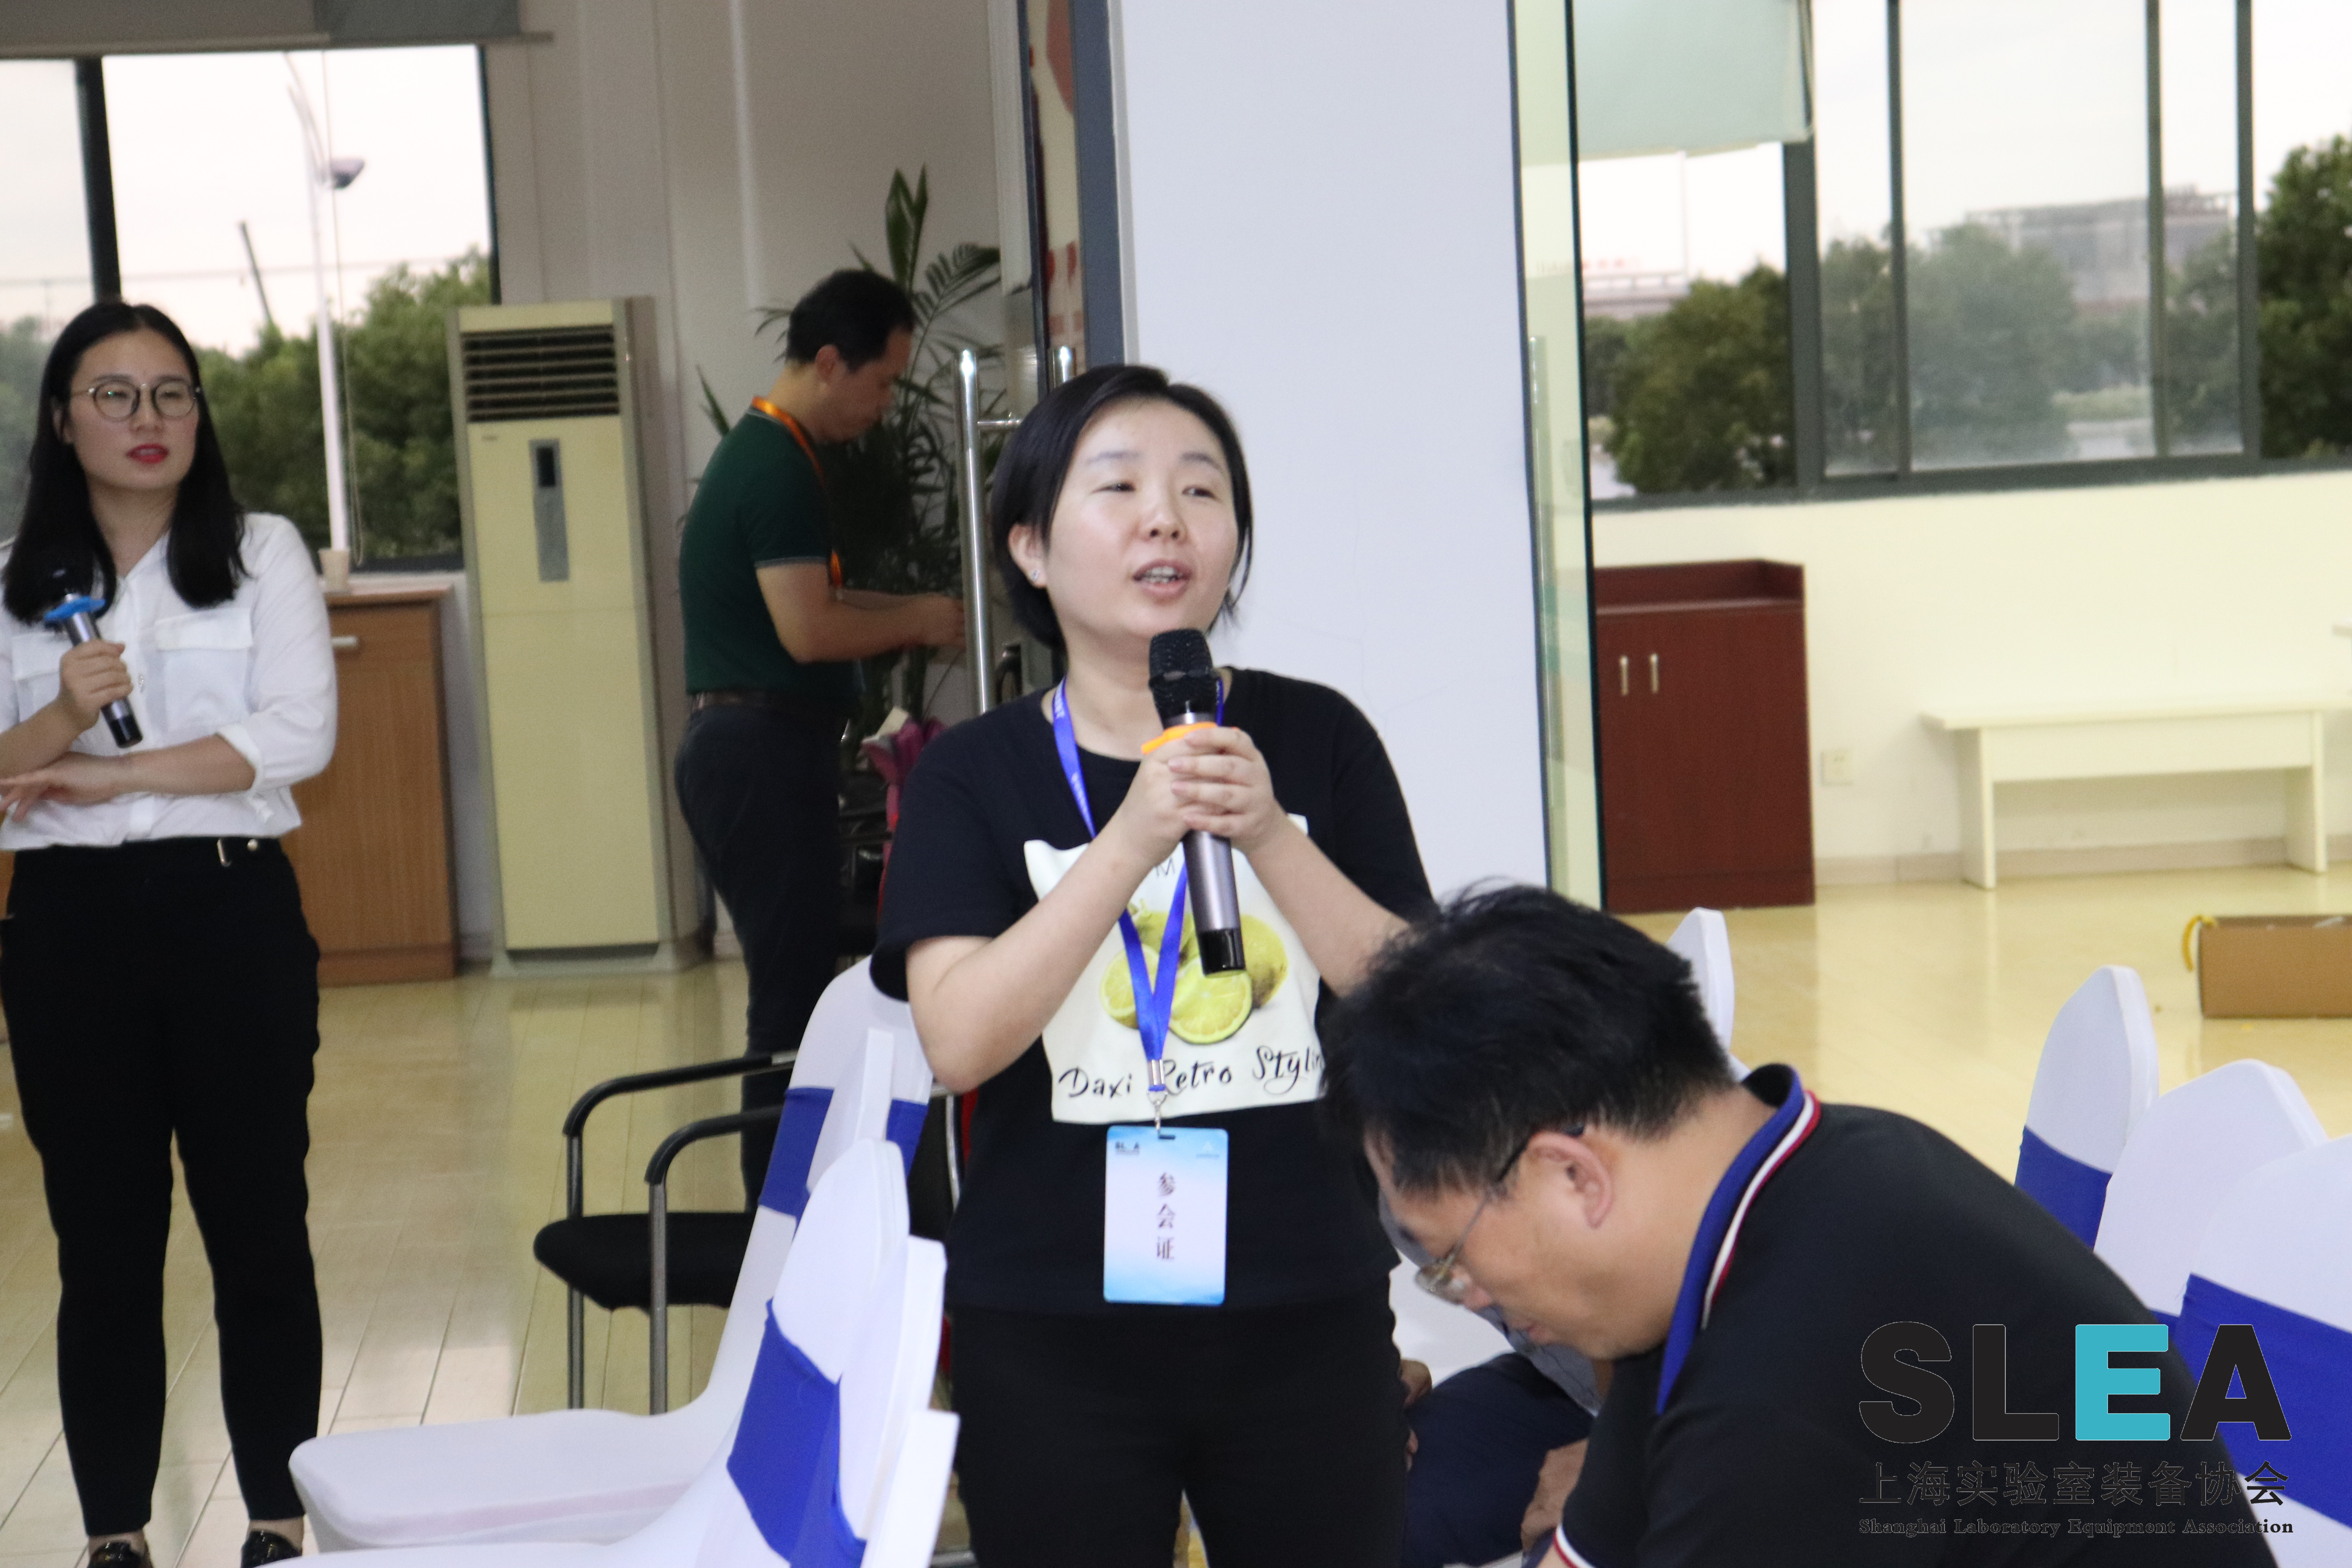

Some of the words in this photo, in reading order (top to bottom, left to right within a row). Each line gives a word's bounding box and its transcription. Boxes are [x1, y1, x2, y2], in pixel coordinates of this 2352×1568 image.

[1058, 1066, 1132, 1099] Daxi
[1156, 1172, 1175, 1259] 参会证
